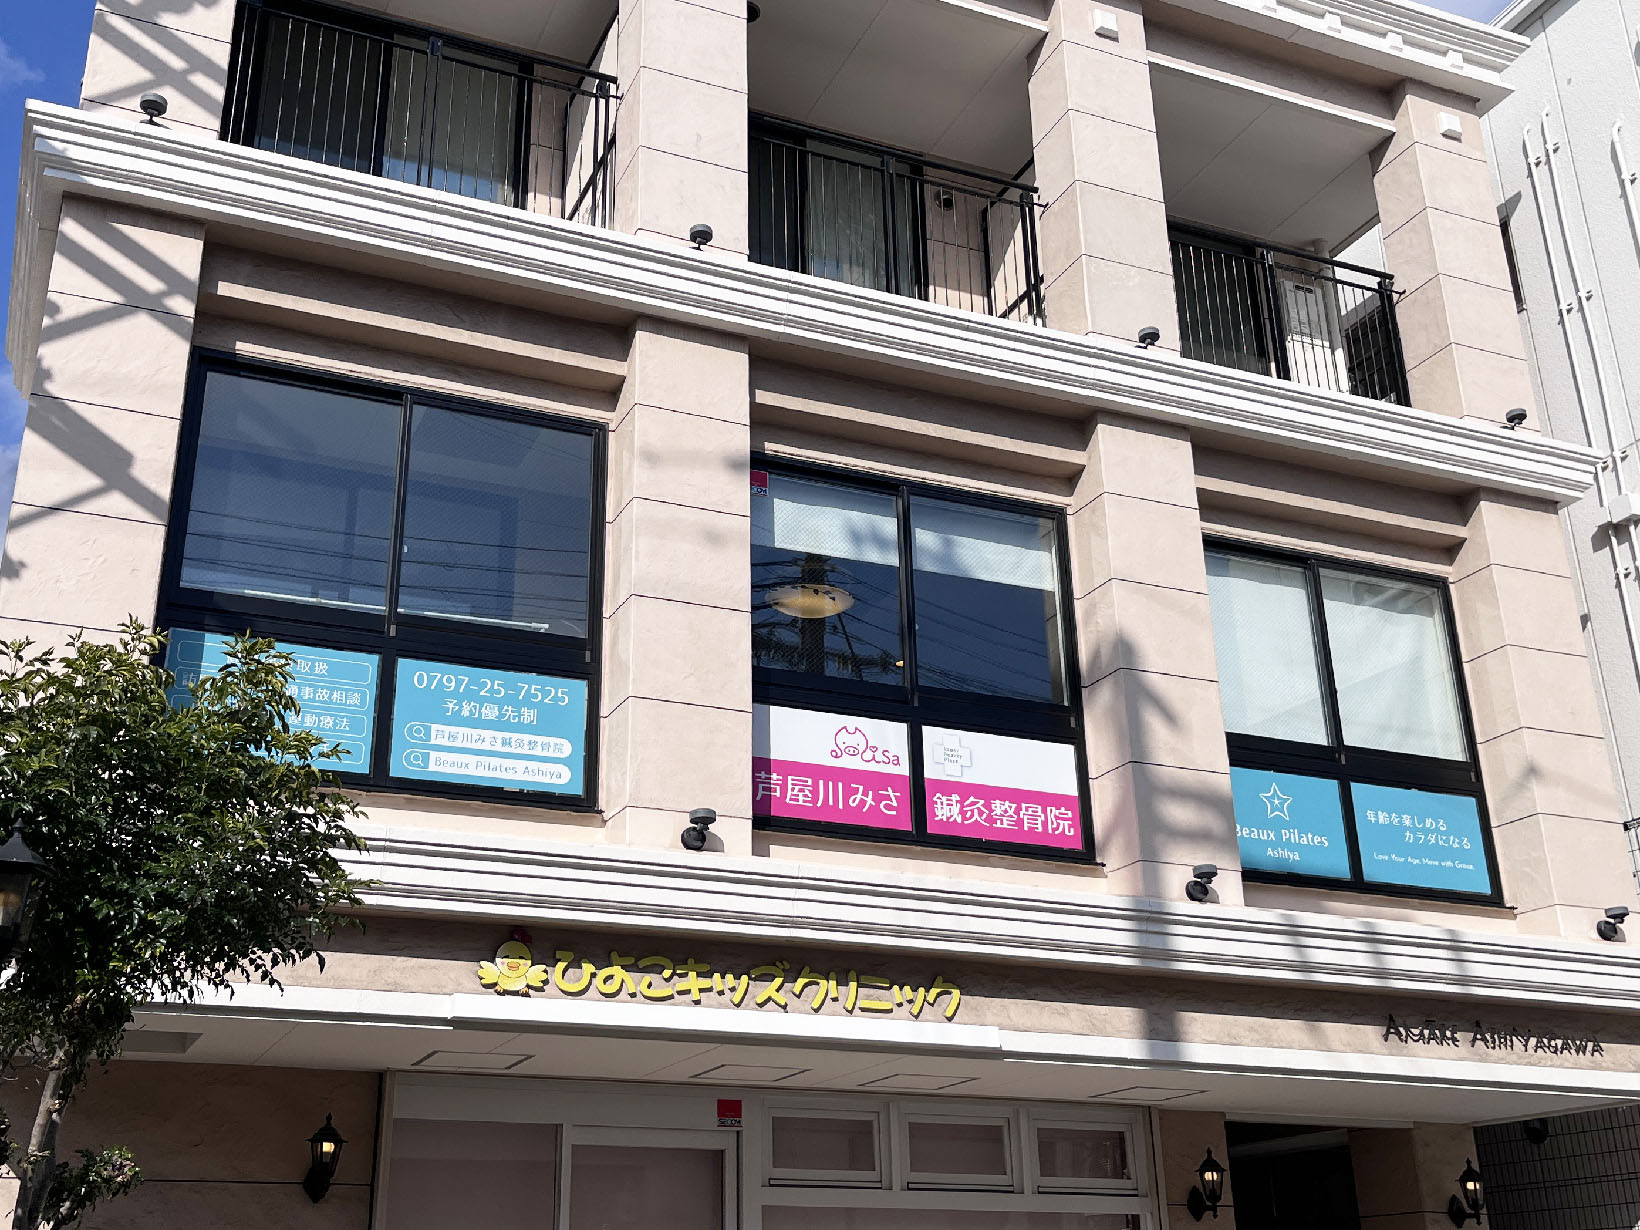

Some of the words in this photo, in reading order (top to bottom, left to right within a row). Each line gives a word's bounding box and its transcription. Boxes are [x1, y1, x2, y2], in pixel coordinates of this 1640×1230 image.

[413, 671, 569, 706] 0797-25-7525
[441, 698, 537, 725] 予約優先制
[434, 729, 565, 754] 芦屋川みさ鍼灸整骨院
[434, 756, 470, 770] Beaux
[475, 760, 518, 775] Pilates
[522, 763, 562, 780] Ashiya
[754, 771, 901, 816] 芦屋川みさ
[932, 792, 1075, 836] 鍼灸整骨院
[1366, 809, 1447, 831] 年齢を楽しめる
[1281, 828, 1329, 848] Pilates
[1404, 830, 1471, 849] カラダになる
[1266, 847, 1300, 863] Ashiya
[552, 948, 962, 1020] ひよこキッズクリニック
